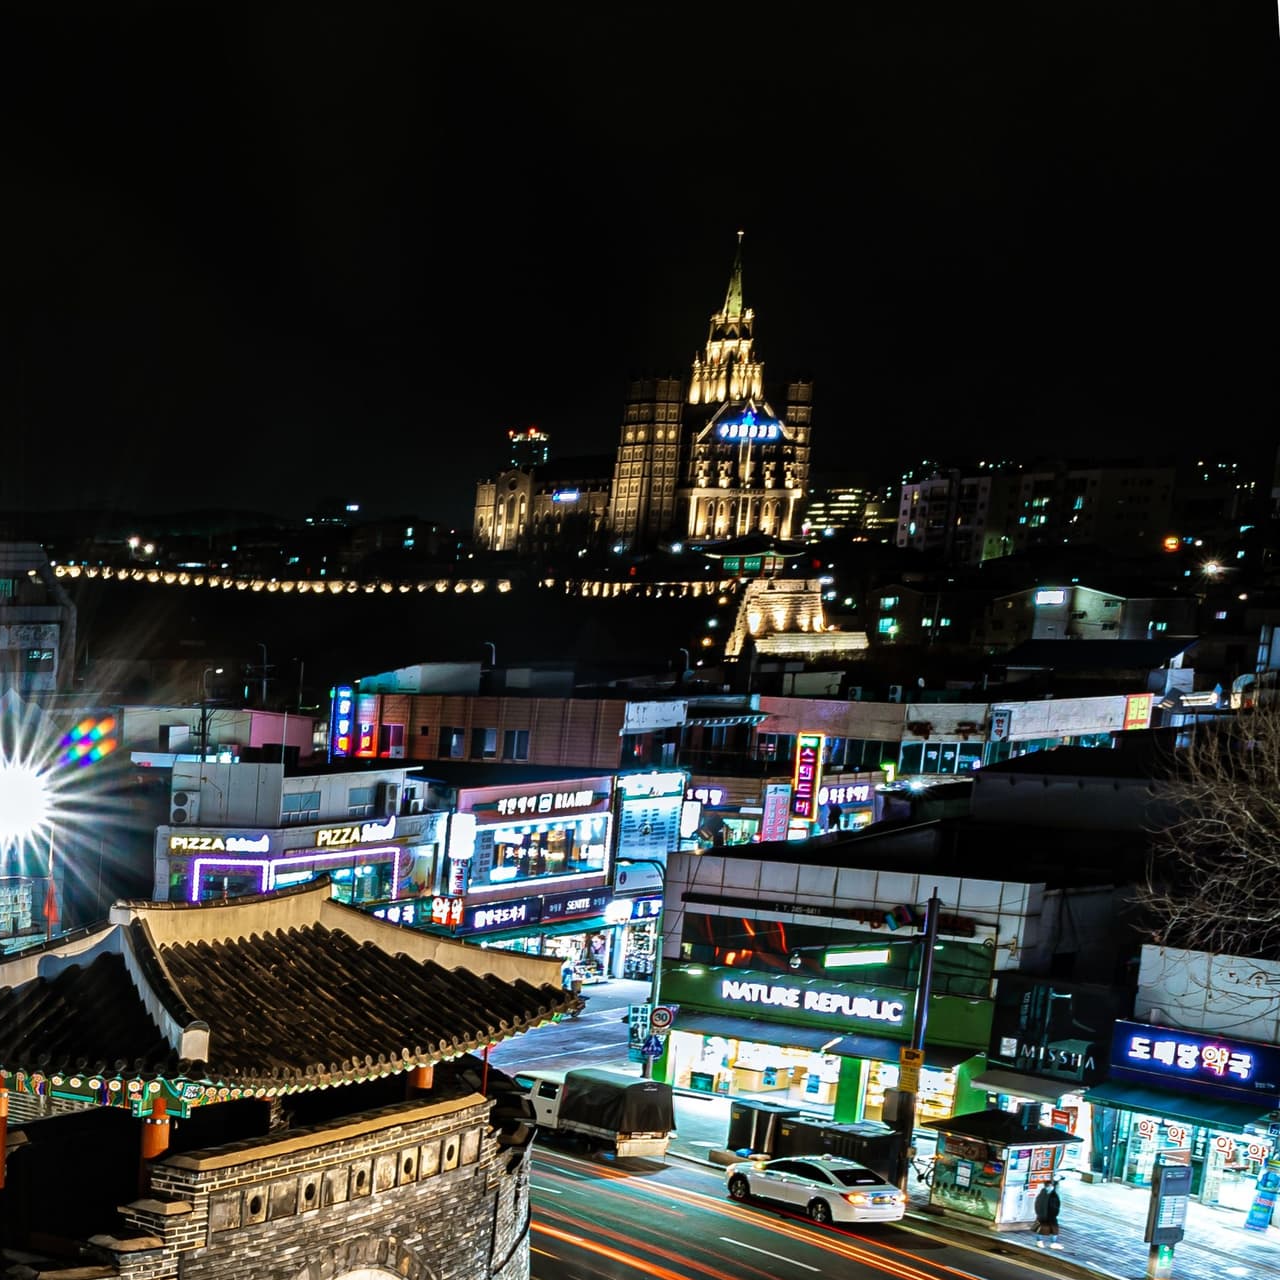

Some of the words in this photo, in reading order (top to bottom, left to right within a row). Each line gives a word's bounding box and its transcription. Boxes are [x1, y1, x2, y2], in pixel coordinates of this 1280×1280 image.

[170, 836, 226, 850] PIZZA
[317, 826, 361, 847] PIZZA
[432, 897, 449, 924] 약
[722, 980, 800, 1008] NATURE
[804, 991, 903, 1022] REPUBLIC
[654, 1012, 668, 1022] 30
[1021, 1044, 1095, 1070] MISSHA
[1139, 1120, 1154, 1140] 약
[1168, 1127, 1185, 1147] 약
[1216, 1137, 1233, 1158] 약
[1248, 1144, 1267, 1165] 약
